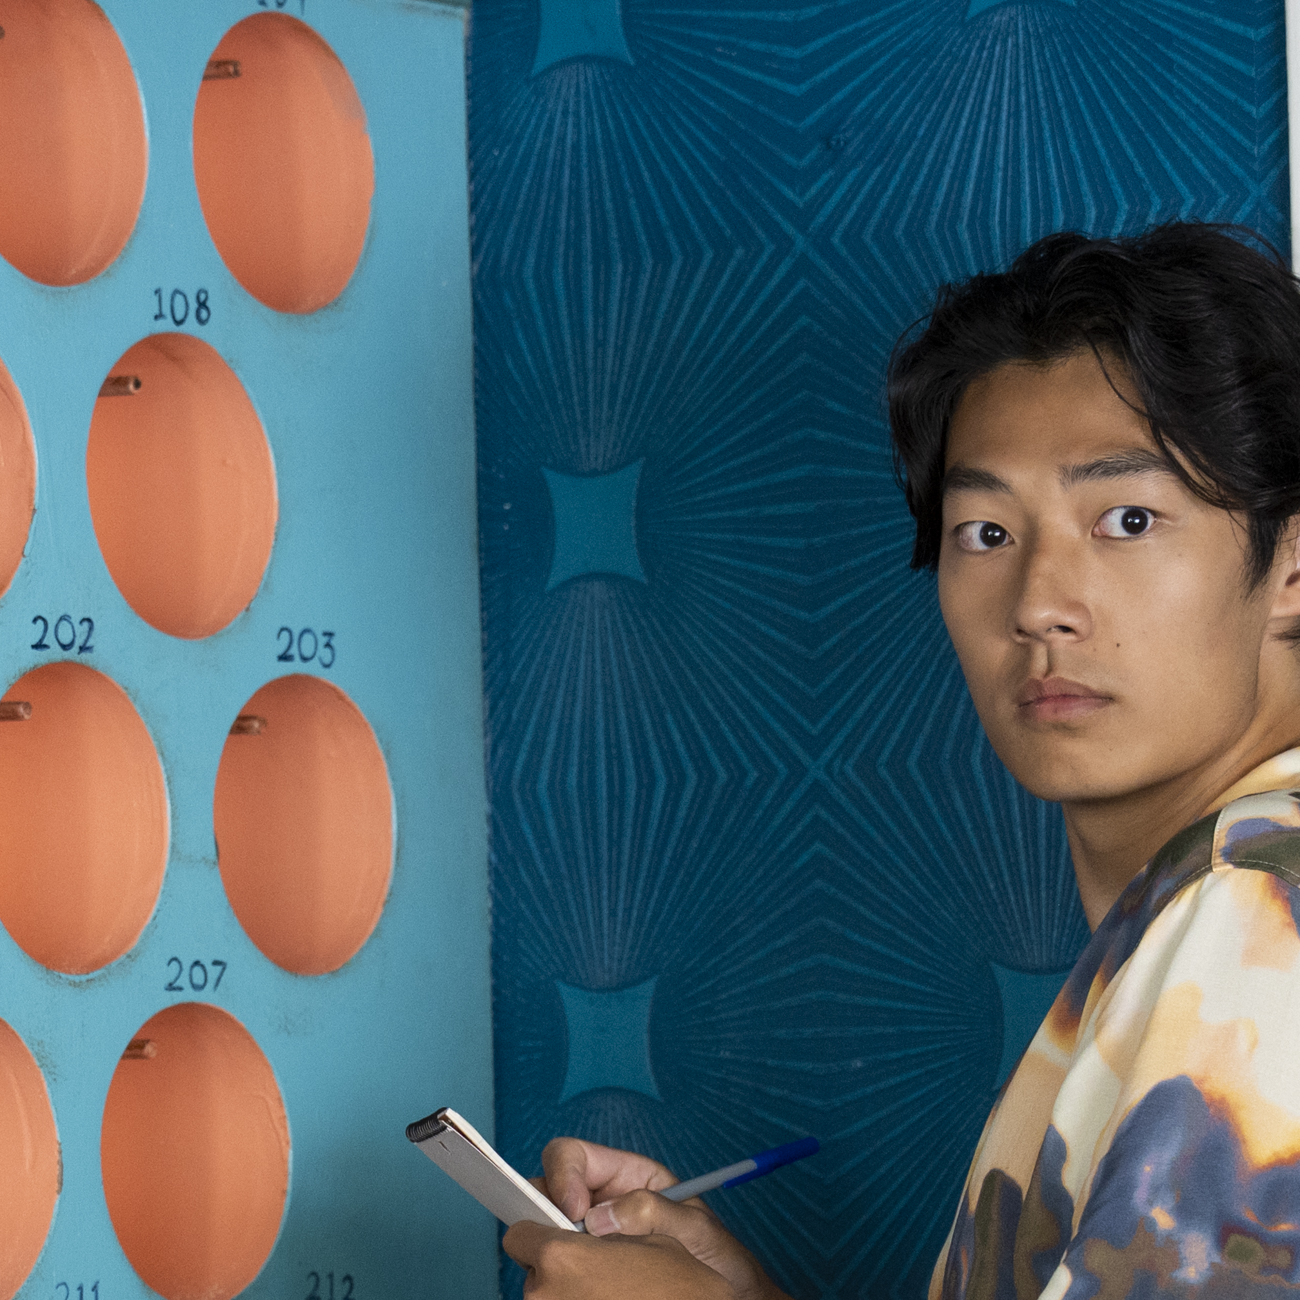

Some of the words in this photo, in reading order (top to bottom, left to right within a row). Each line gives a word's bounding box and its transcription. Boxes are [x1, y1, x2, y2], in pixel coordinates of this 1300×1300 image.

[152, 288, 213, 327] 108
[30, 615, 96, 656] 202
[276, 627, 338, 669] 203
[164, 957, 228, 993] 207
